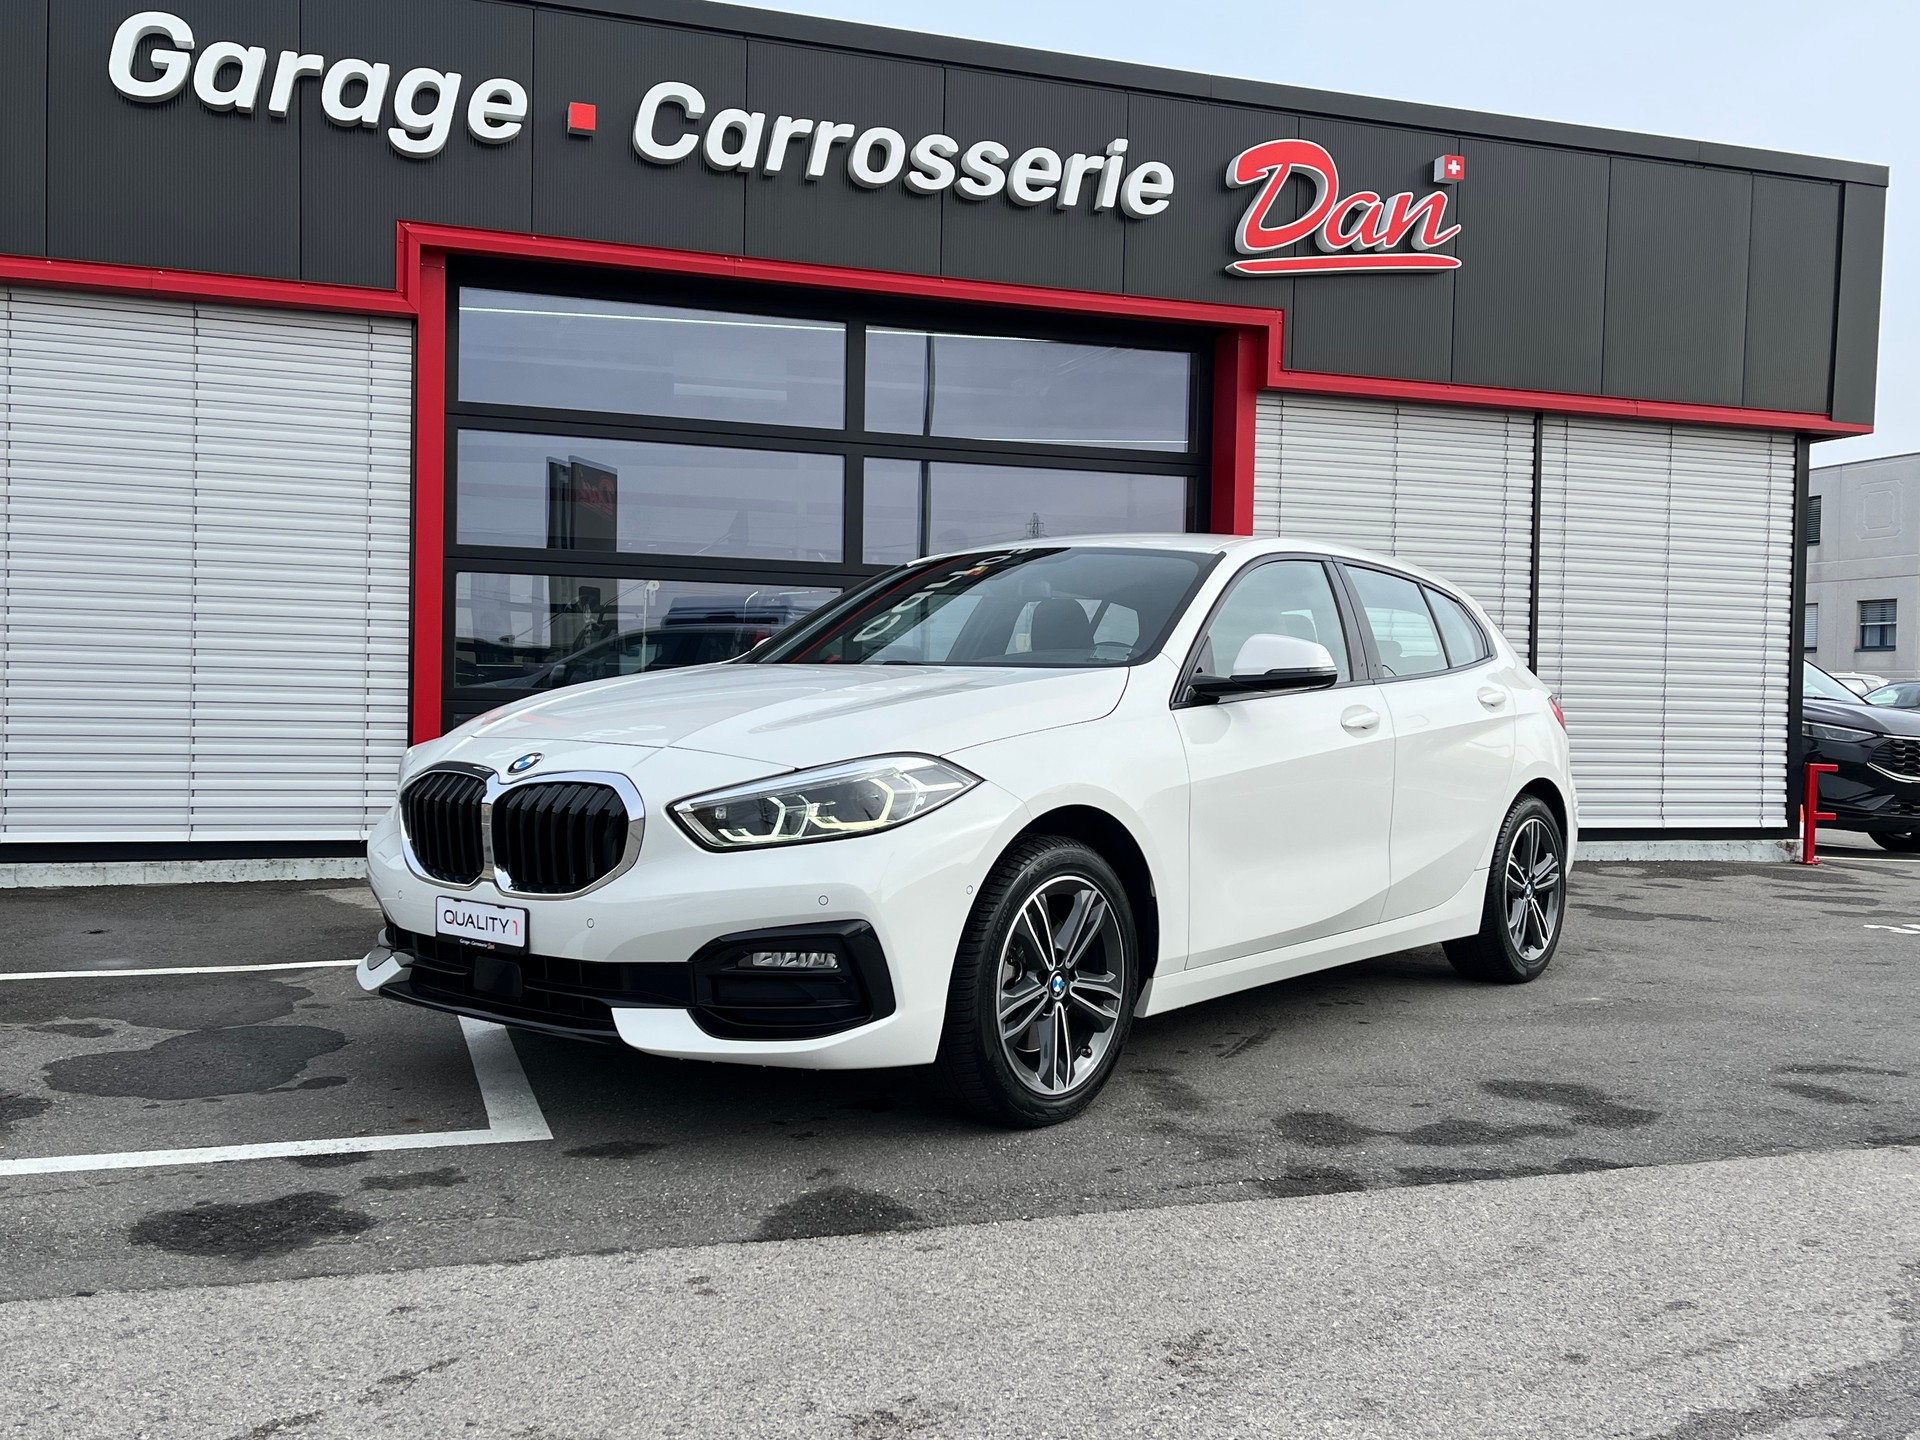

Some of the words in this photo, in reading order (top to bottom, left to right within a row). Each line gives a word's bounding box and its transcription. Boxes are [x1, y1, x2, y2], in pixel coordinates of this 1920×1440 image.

[108, 11, 528, 159] Garage
[632, 81, 1175, 220] Carrosserie
[443, 909, 509, 934] QUALITY
